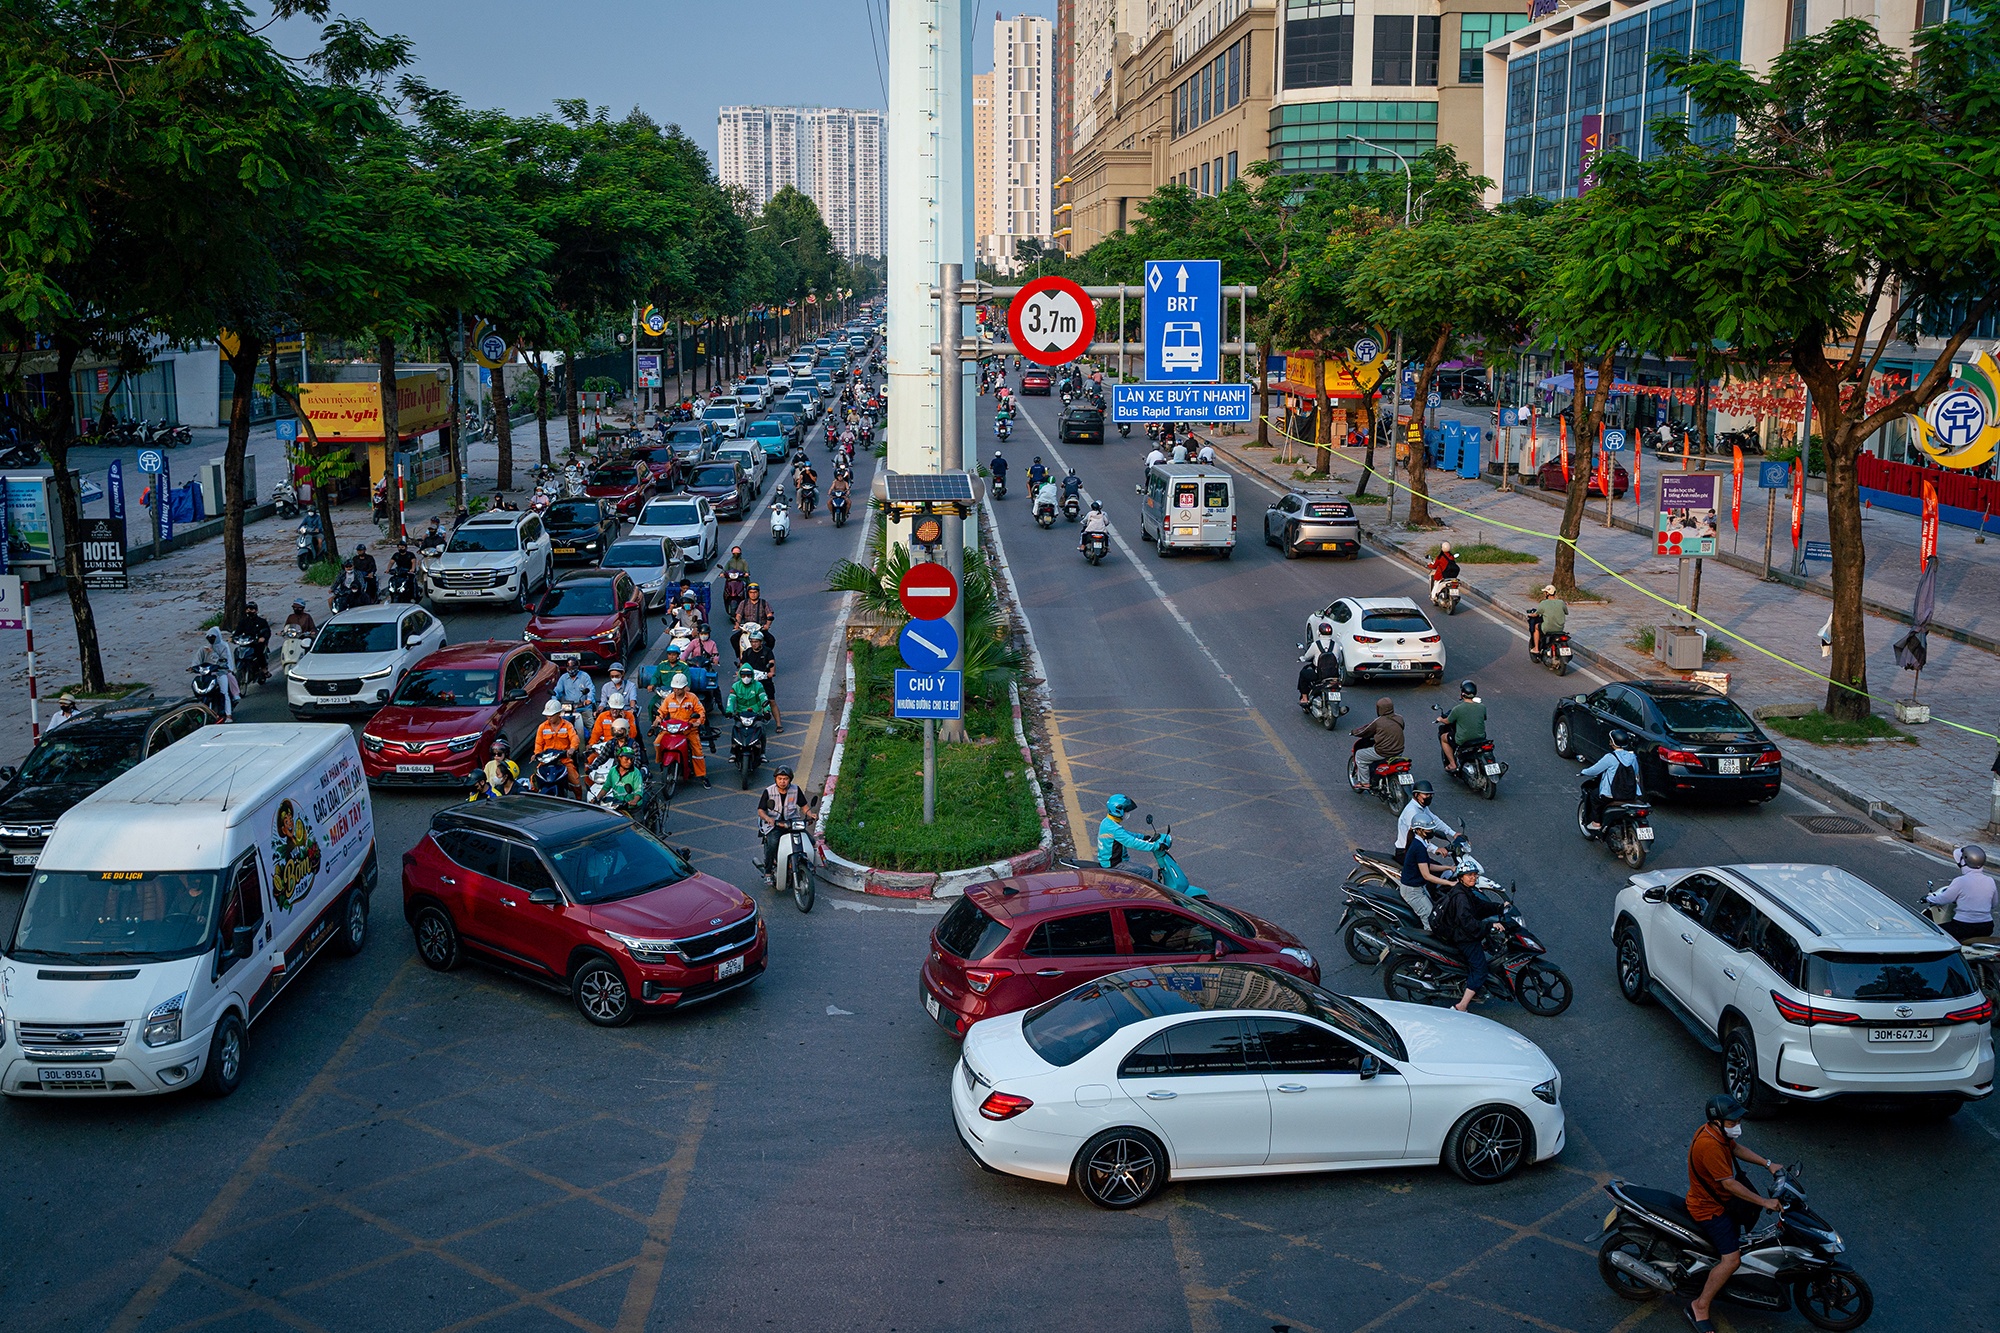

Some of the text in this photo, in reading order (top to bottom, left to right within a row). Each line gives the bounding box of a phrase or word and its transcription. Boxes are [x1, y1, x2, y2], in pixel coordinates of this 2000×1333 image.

[1167, 296, 1198, 312] BRT
[1028, 304, 1076, 334] 3,7m
[1118, 388, 1246, 402] LÀN XE BUÝT NHANH
[306, 408, 378, 422] Hữu Nghị
[1118, 404, 1245, 418] Bus Rapid Transit (BRT)
[1664, 488, 1668, 498] 1
[82, 542, 124, 560] HOTEL
[909, 676, 945, 692] CHÚ Ý
[943, 701, 949, 710] XE
[313, 796, 328, 824] CÁC
[325, 786, 340, 813] LOẠI
[329, 802, 362, 846] MIỀN TÂY
[125, 872, 143, 881] LỊCH
[1874, 1030, 1928, 1040] 30M-647.34
[45, 1070, 96, 1079] 30L-899.64
